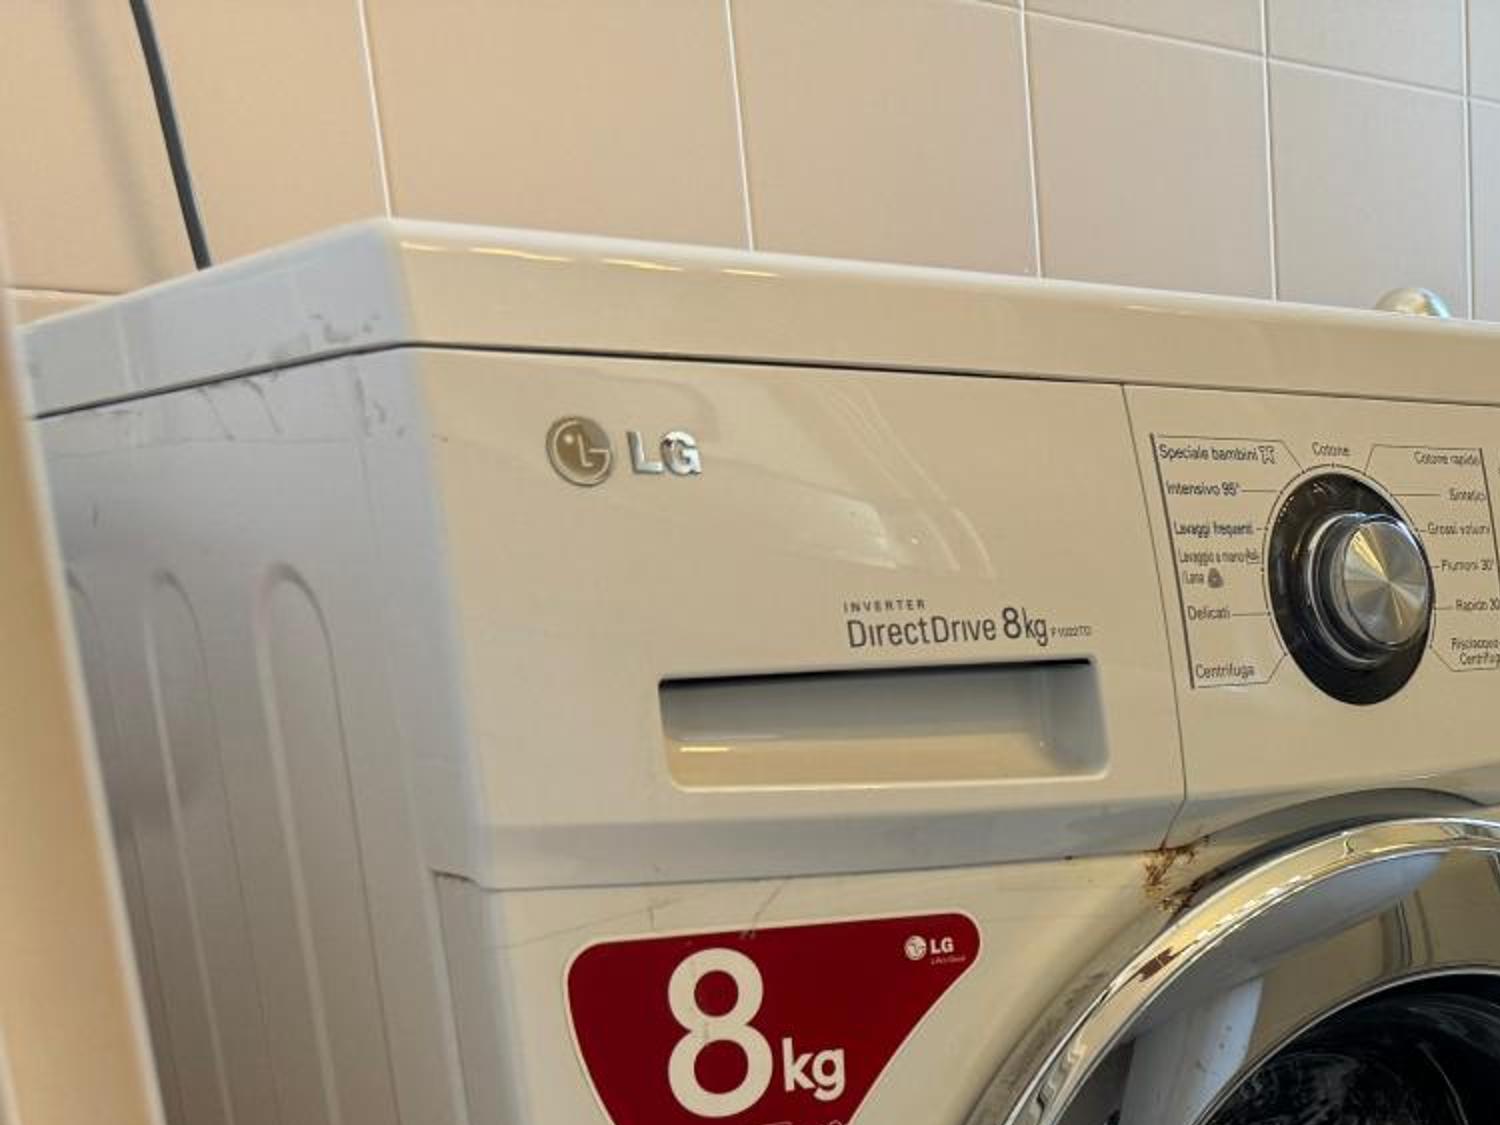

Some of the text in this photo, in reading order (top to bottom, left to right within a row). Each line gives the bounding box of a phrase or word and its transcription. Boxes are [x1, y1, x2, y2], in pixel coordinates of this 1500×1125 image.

[626, 430, 702, 476] LG
[1159, 444, 1258, 462] Speciale bambini
[1311, 441, 1351, 457] Cotone
[1165, 480, 1220, 496] Intensivo
[1173, 520, 1210, 538] Lavaggi
[842, 599, 926, 614] INVERTER
[1187, 604, 1231, 621] Delicati
[1195, 662, 1256, 679] Centrifuga
[930, 936, 955, 955] LG
